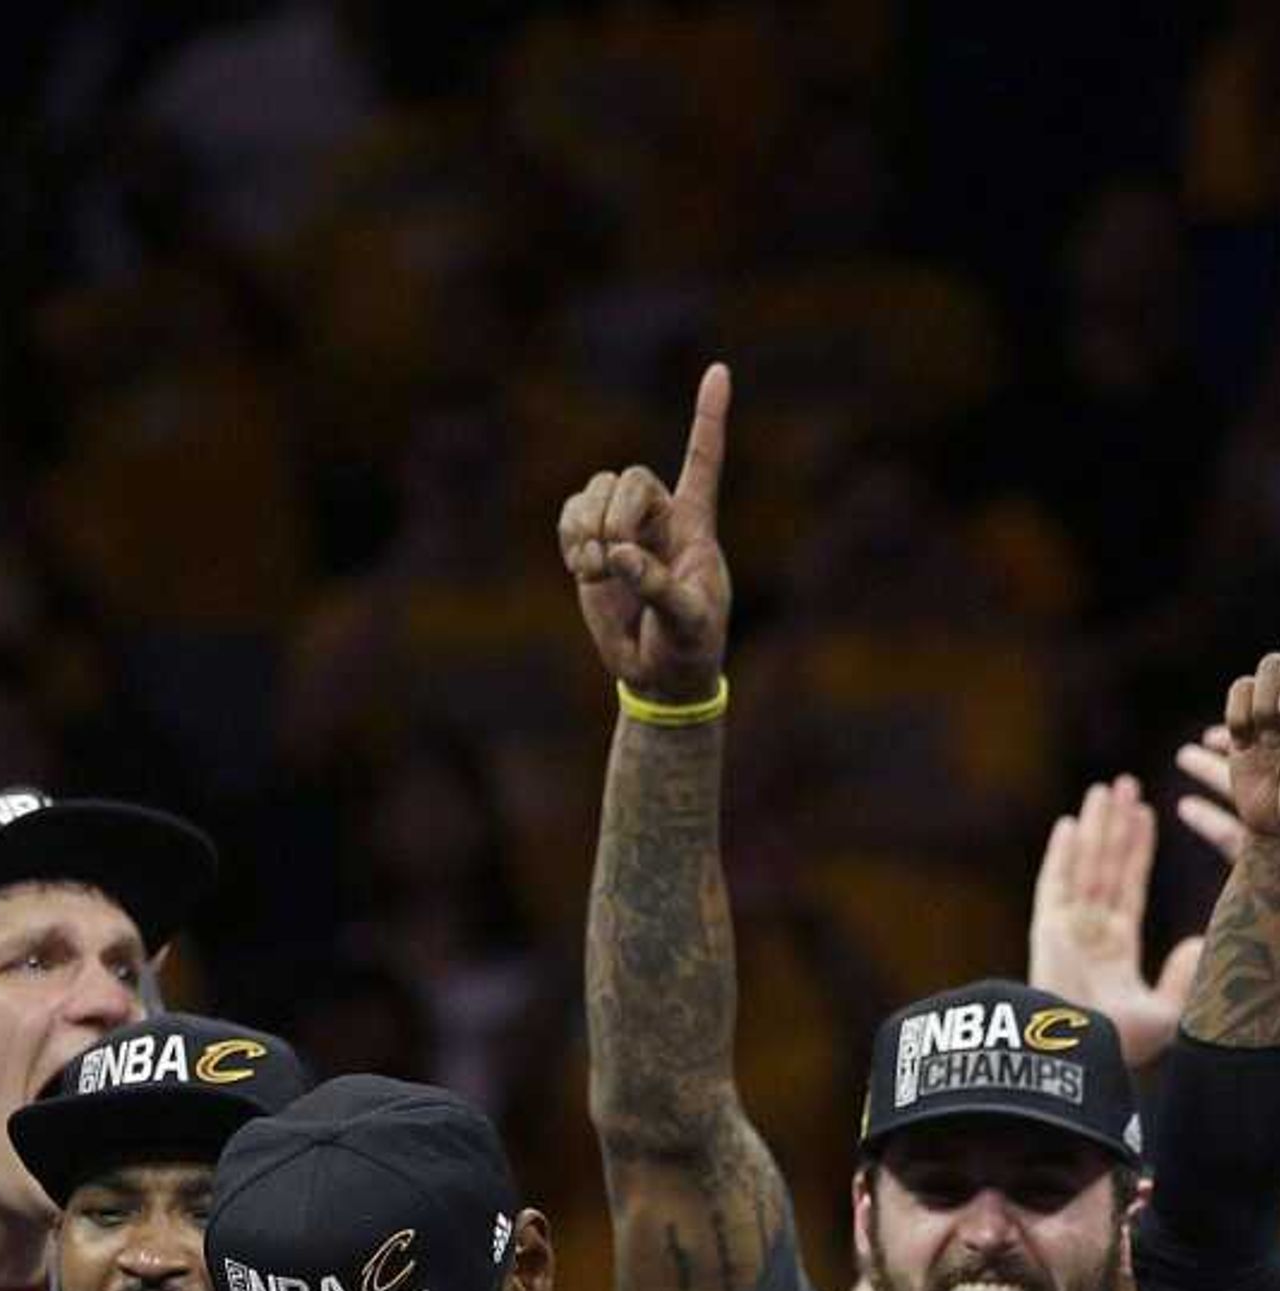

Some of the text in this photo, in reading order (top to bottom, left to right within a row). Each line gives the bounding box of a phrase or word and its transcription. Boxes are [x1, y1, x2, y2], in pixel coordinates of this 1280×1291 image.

[922, 1003, 1020, 1056] NBA
[98, 1034, 189, 1092] NBA
[922, 1052, 1083, 1104] CHAMPS
